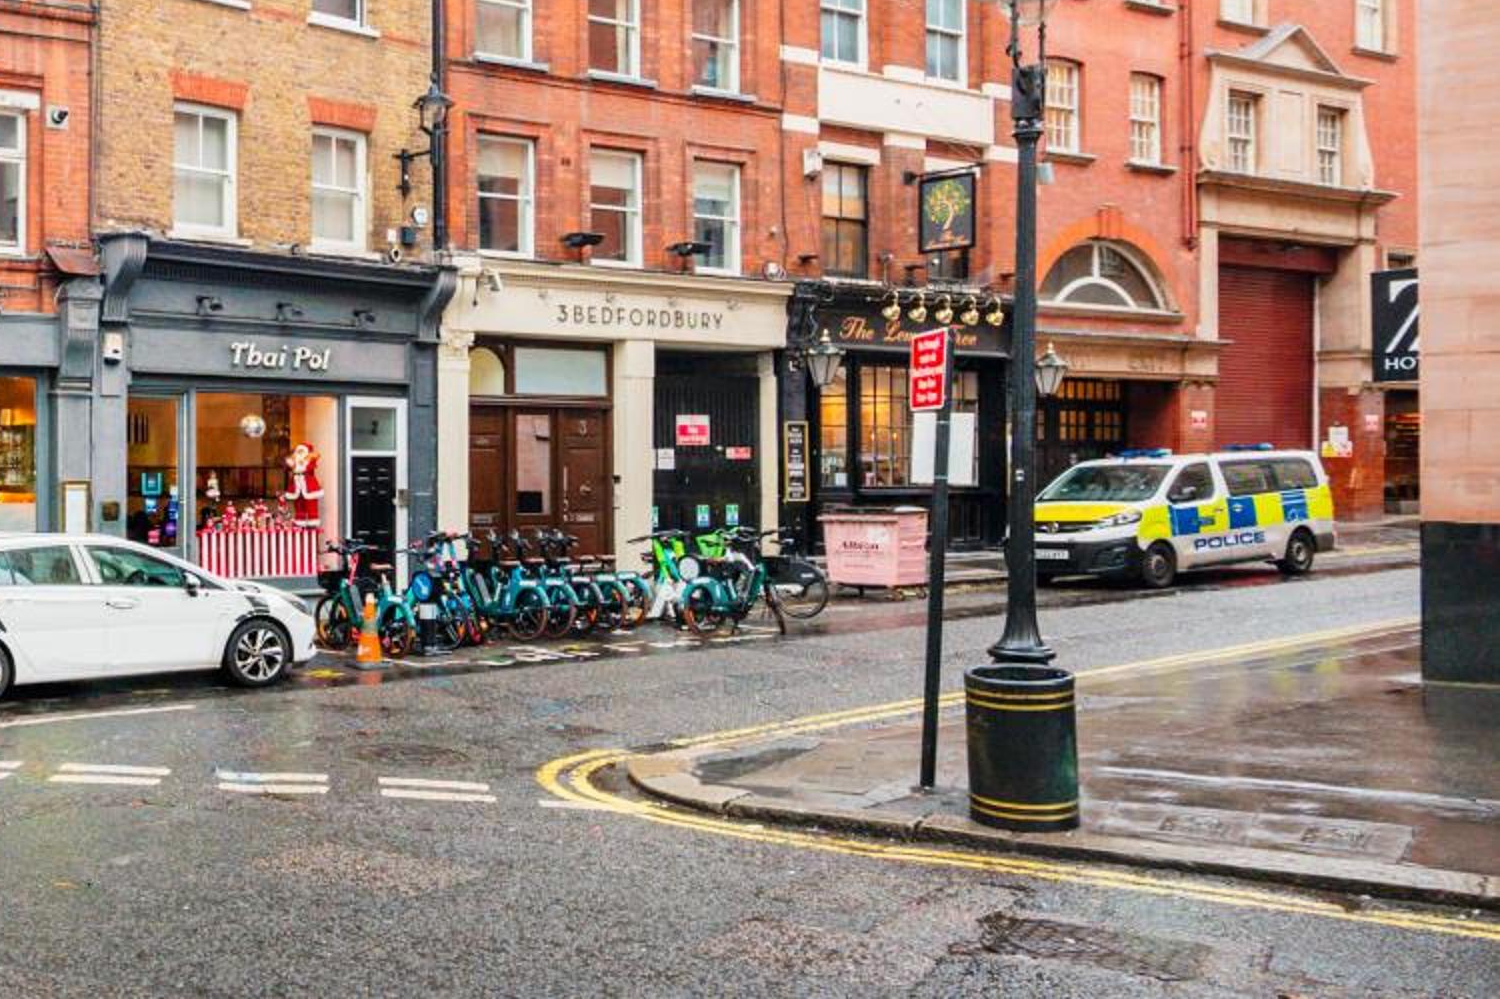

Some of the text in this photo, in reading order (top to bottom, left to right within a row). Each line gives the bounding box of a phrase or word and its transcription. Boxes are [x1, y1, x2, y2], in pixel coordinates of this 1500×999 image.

[839, 316, 875, 340] The
[230, 341, 288, 368] Thai
[1194, 531, 1266, 550] POLICE
